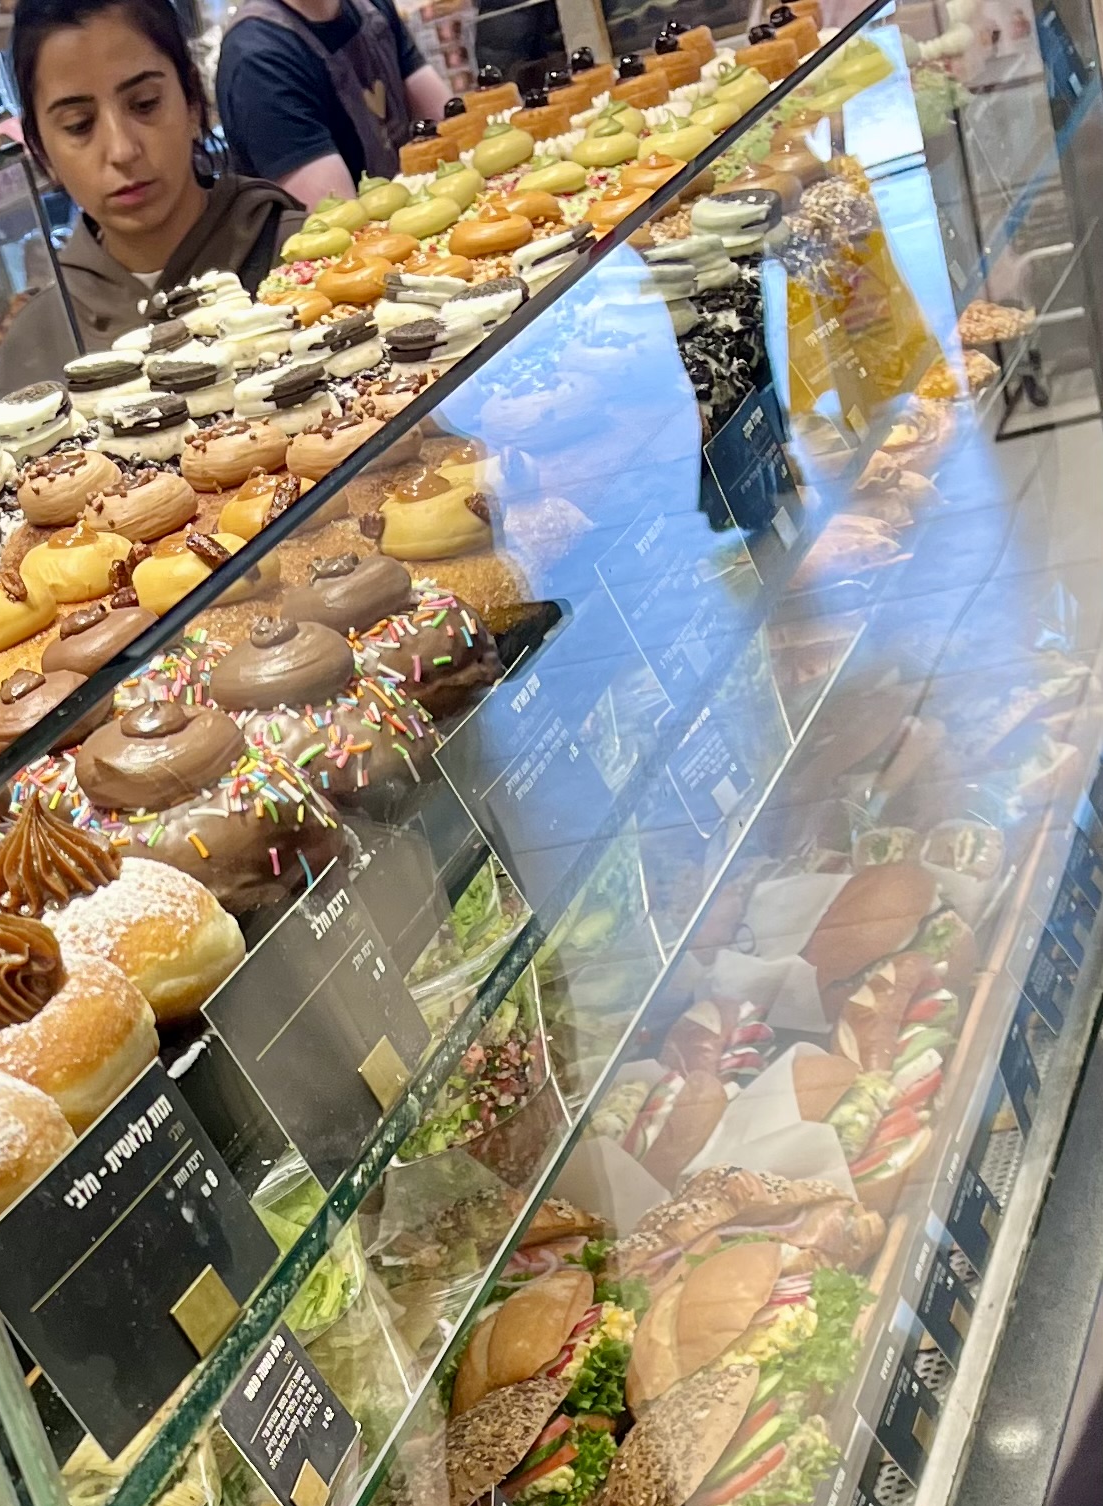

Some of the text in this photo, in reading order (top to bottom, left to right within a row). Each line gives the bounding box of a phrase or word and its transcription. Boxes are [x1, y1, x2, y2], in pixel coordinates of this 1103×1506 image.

[310, 888, 350, 940] ריבת חלב
[351, 939, 375, 972] ריבת חלב
[146, 1094, 173, 1128] תות
[104, 1116, 152, 1173] קלאסית
[167, 1120, 186, 1142] חלבי
[172, 1149, 205, 1189] ריבת תות
[64, 1172, 101, 1209] חלבי
